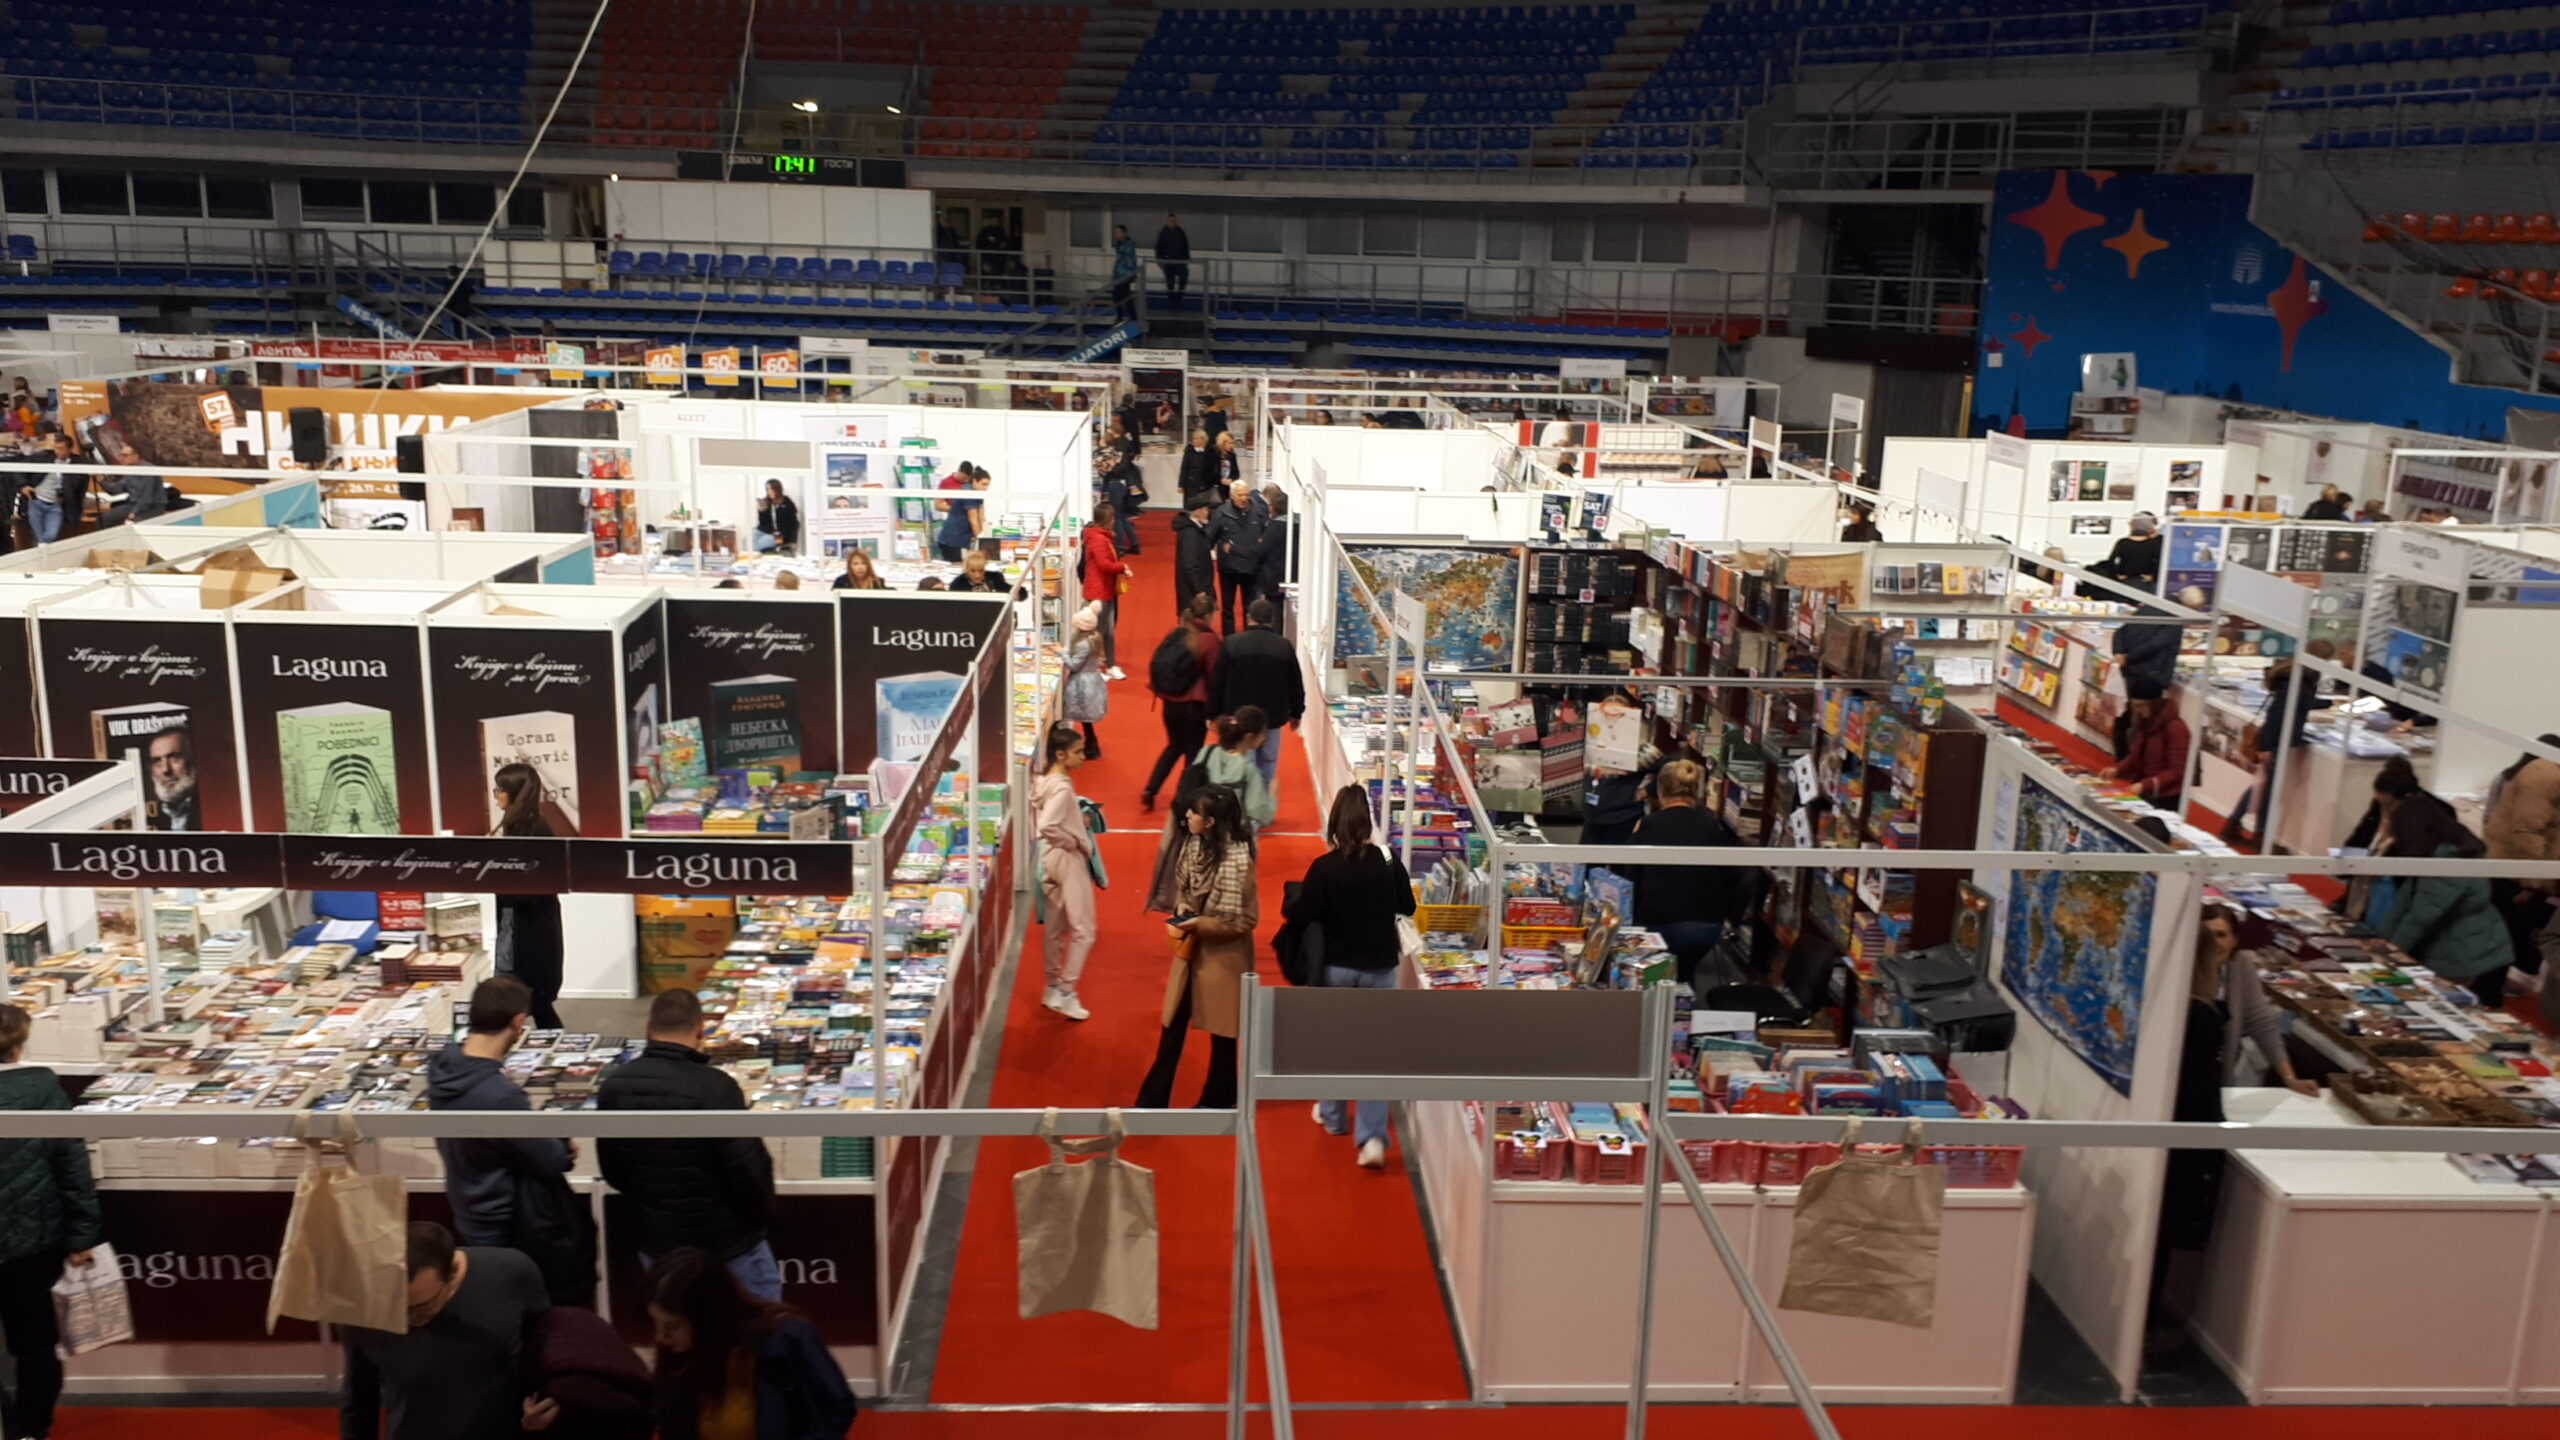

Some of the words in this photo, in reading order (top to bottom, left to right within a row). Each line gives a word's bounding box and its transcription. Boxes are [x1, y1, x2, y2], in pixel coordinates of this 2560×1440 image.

[774, 155, 815, 173] 17:41
[823, 158, 854, 169] ГОСТИ
[677, 414, 707, 423] KLETT
[1583, 501, 1602, 511] SAT
[688, 625, 742, 648] Knjige
[744, 631, 753, 639] o
[754, 622, 808, 649] kojima
[872, 625, 976, 651] Laguna
[68, 647, 127, 673] Knjige
[128, 654, 138, 663] o
[139, 644, 198, 674] kojima
[735, 642, 756, 655] se
[762, 641, 815, 661] priča
[119, 666, 141, 680] se
[149, 664, 207, 686] priča
[272, 655, 388, 682] Laguna
[454, 655, 513, 681] Knjige
[514, 662, 524, 671] o
[525, 652, 583, 682] kojima
[505, 674, 527, 688] se
[534, 672, 592, 694] priča
[108, 719, 131, 736] VUK
[731, 719, 789, 736] НЕБЕСКА
[506, 732, 557, 746] Goran
[724, 735, 796, 755] ДВОРИШТА
[50, 842, 228, 881] Laguna
[312, 851, 381, 879] Knjige
[380, 860, 392, 868] o
[392, 848, 459, 880] kojima
[455, 859, 478, 875] se
[474, 857, 540, 882] priča
[625, 850, 799, 888] Laguna
[116, 1251, 276, 1289] aguna
